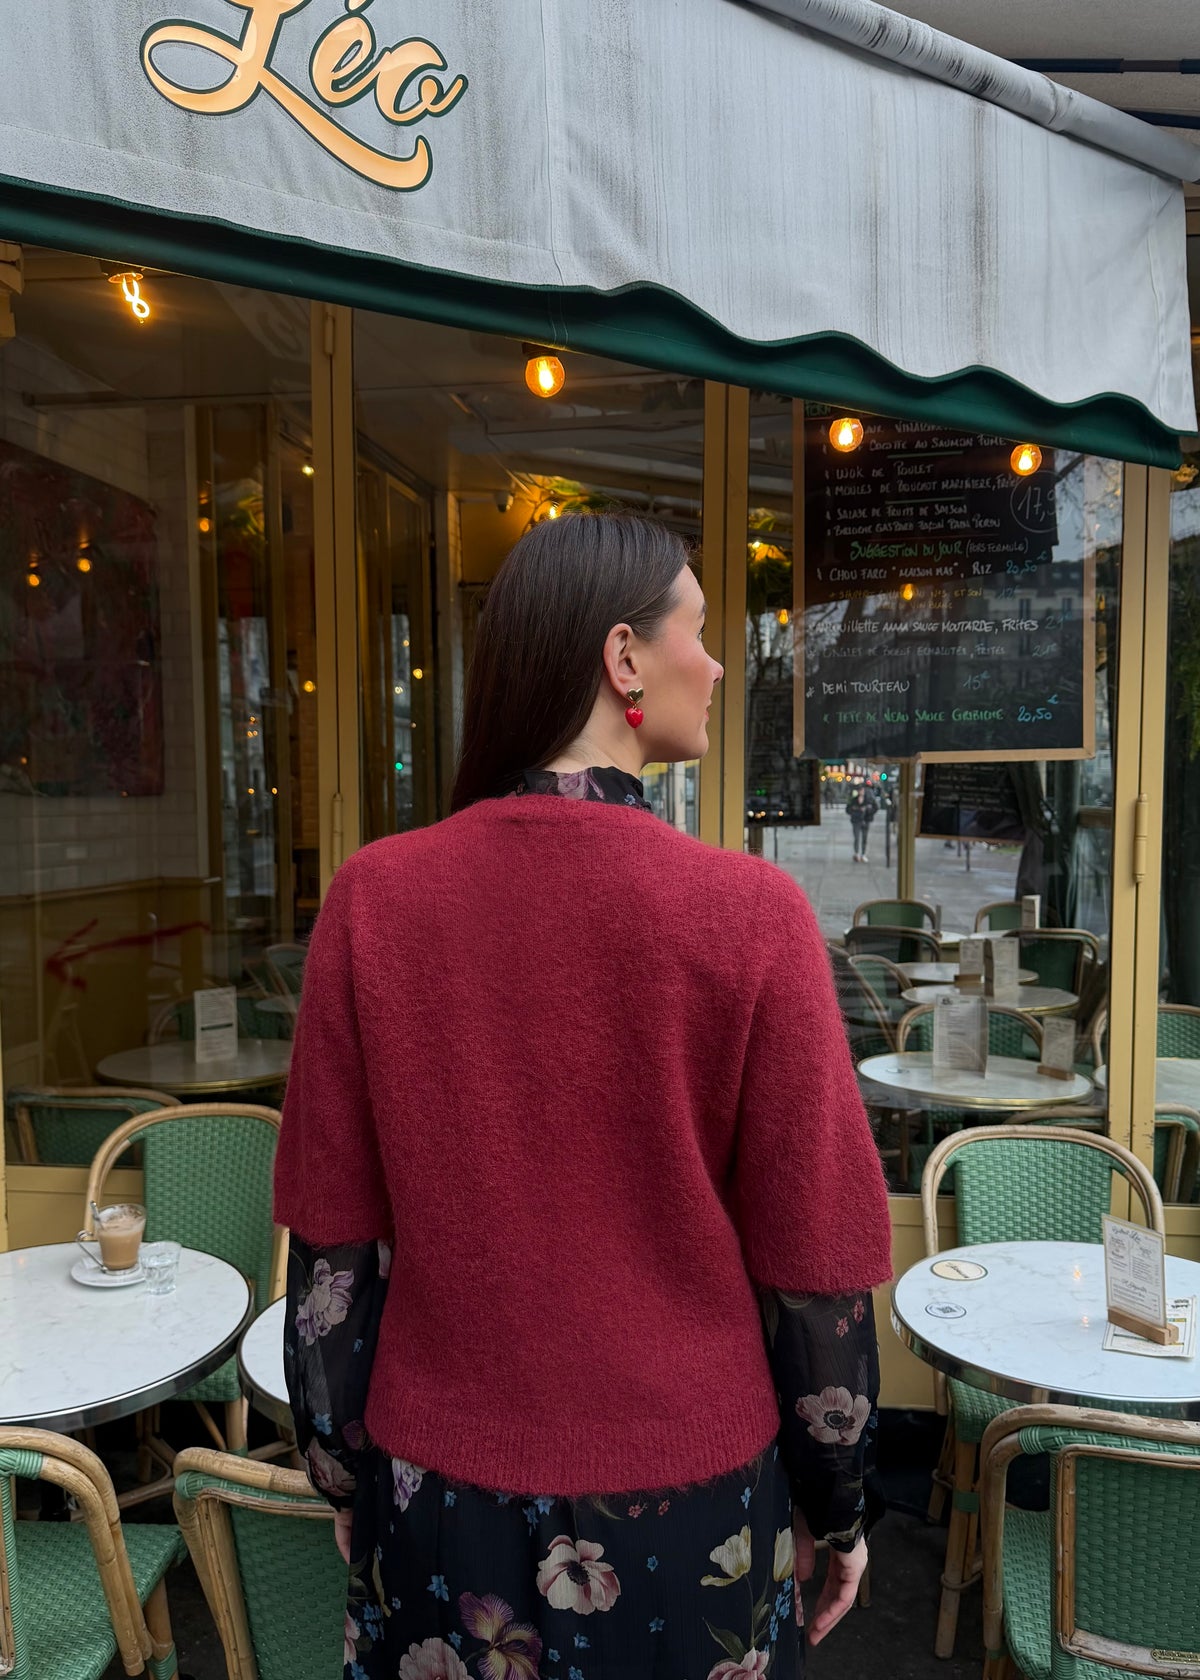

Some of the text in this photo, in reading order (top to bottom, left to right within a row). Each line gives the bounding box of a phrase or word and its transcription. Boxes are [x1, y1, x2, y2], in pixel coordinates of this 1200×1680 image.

[914, 438, 928, 449] AU
[931, 436, 974, 448] SAUMON
[836, 461, 934, 480] WOK DE POULET
[834, 483, 872, 496] MOULES
[880, 483, 890, 494] DE
[836, 503, 967, 520] SALADE DE FRUITS DE SAISON
[922, 542, 934, 556] DU
[933, 541, 963, 563] JOUR
[829, 567, 858, 582] CHOU
[860, 568, 888, 581] FARCI
[972, 561, 992, 576] RIZ
[912, 621, 939, 633] SAUCE
[850, 679, 910, 694] TOURTEAU
[865, 710, 878, 723] DE
[883, 706, 909, 722] VEAU
[914, 708, 945, 722] SAUCE
